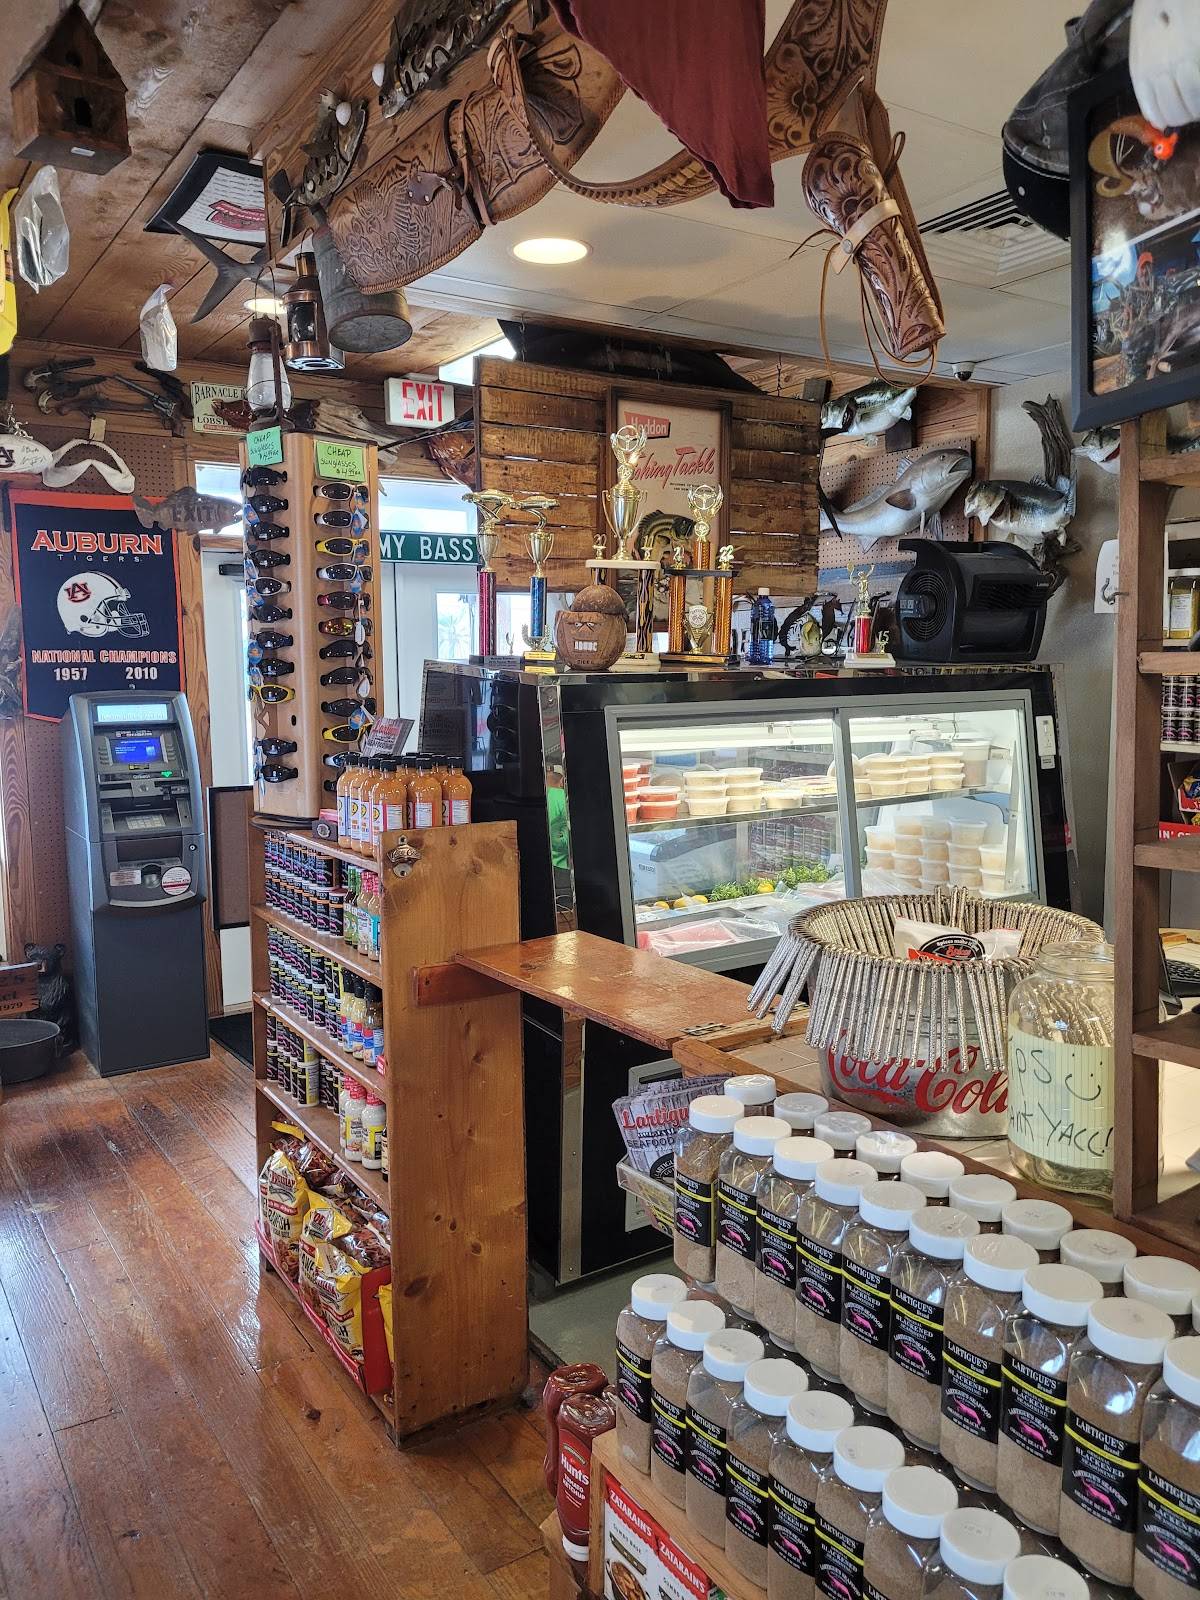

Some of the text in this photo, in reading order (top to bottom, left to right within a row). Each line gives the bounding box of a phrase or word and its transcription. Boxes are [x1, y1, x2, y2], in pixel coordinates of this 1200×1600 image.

[194, 385, 239, 404] BARNACLE
[402, 381, 444, 422] EXIT
[327, 446, 352, 458] CHEAP
[674, 446, 716, 476] Tackle
[31, 530, 163, 555] AUBURN
[420, 536, 474, 562] BASS
[57, 553, 141, 562] TIGERS
[878, 631, 890, 642] 15
[32, 650, 177, 664] NATIONAL CHAMPIONS
[54, 666, 158, 681] 1957 2010
[827, 1029, 1008, 1114] Coca-Cola
[622, 1107, 689, 1129] Lartigu
[628, 1137, 675, 1149] SEAFOOD
[802, 1236, 833, 1260] LARTIGUE'S
[846, 1260, 880, 1284] LARTIGUE'S
[846, 1284, 880, 1306] BLACKENED
[896, 1288, 932, 1315] LARTIGUE'S
[896, 1314, 934, 1338] BLACKENED
[948, 1341, 988, 1370] LARTIGUE'S
[948, 1367, 988, 1394] BLACKENED
[970, 1363, 984, 1374] Brand
[1012, 1358, 1056, 1390] LARTIGUE'S
[1037, 1382, 1053, 1394] Brand
[1012, 1386, 1056, 1416] BLACKENED
[1034, 1415, 1059, 1442] SEAFOOD
[1076, 1417, 1125, 1451] LARTIGUE'S
[1076, 1446, 1125, 1478] BLACKENED
[1104, 1444, 1120, 1456] Brand
[562, 1480, 586, 1501] KETCHUP
[564, 1474, 584, 1493] TOMATO
[774, 1480, 808, 1509] LARTIGUE'S
[610, 1490, 652, 1537] ZATARAIN'S
[774, 1504, 809, 1532] BLACKENED
[820, 1518, 856, 1550] LARTIGUE'S
[660, 1542, 706, 1594] ZATARAIN'S
[821, 1544, 858, 1572] BLACKENED
